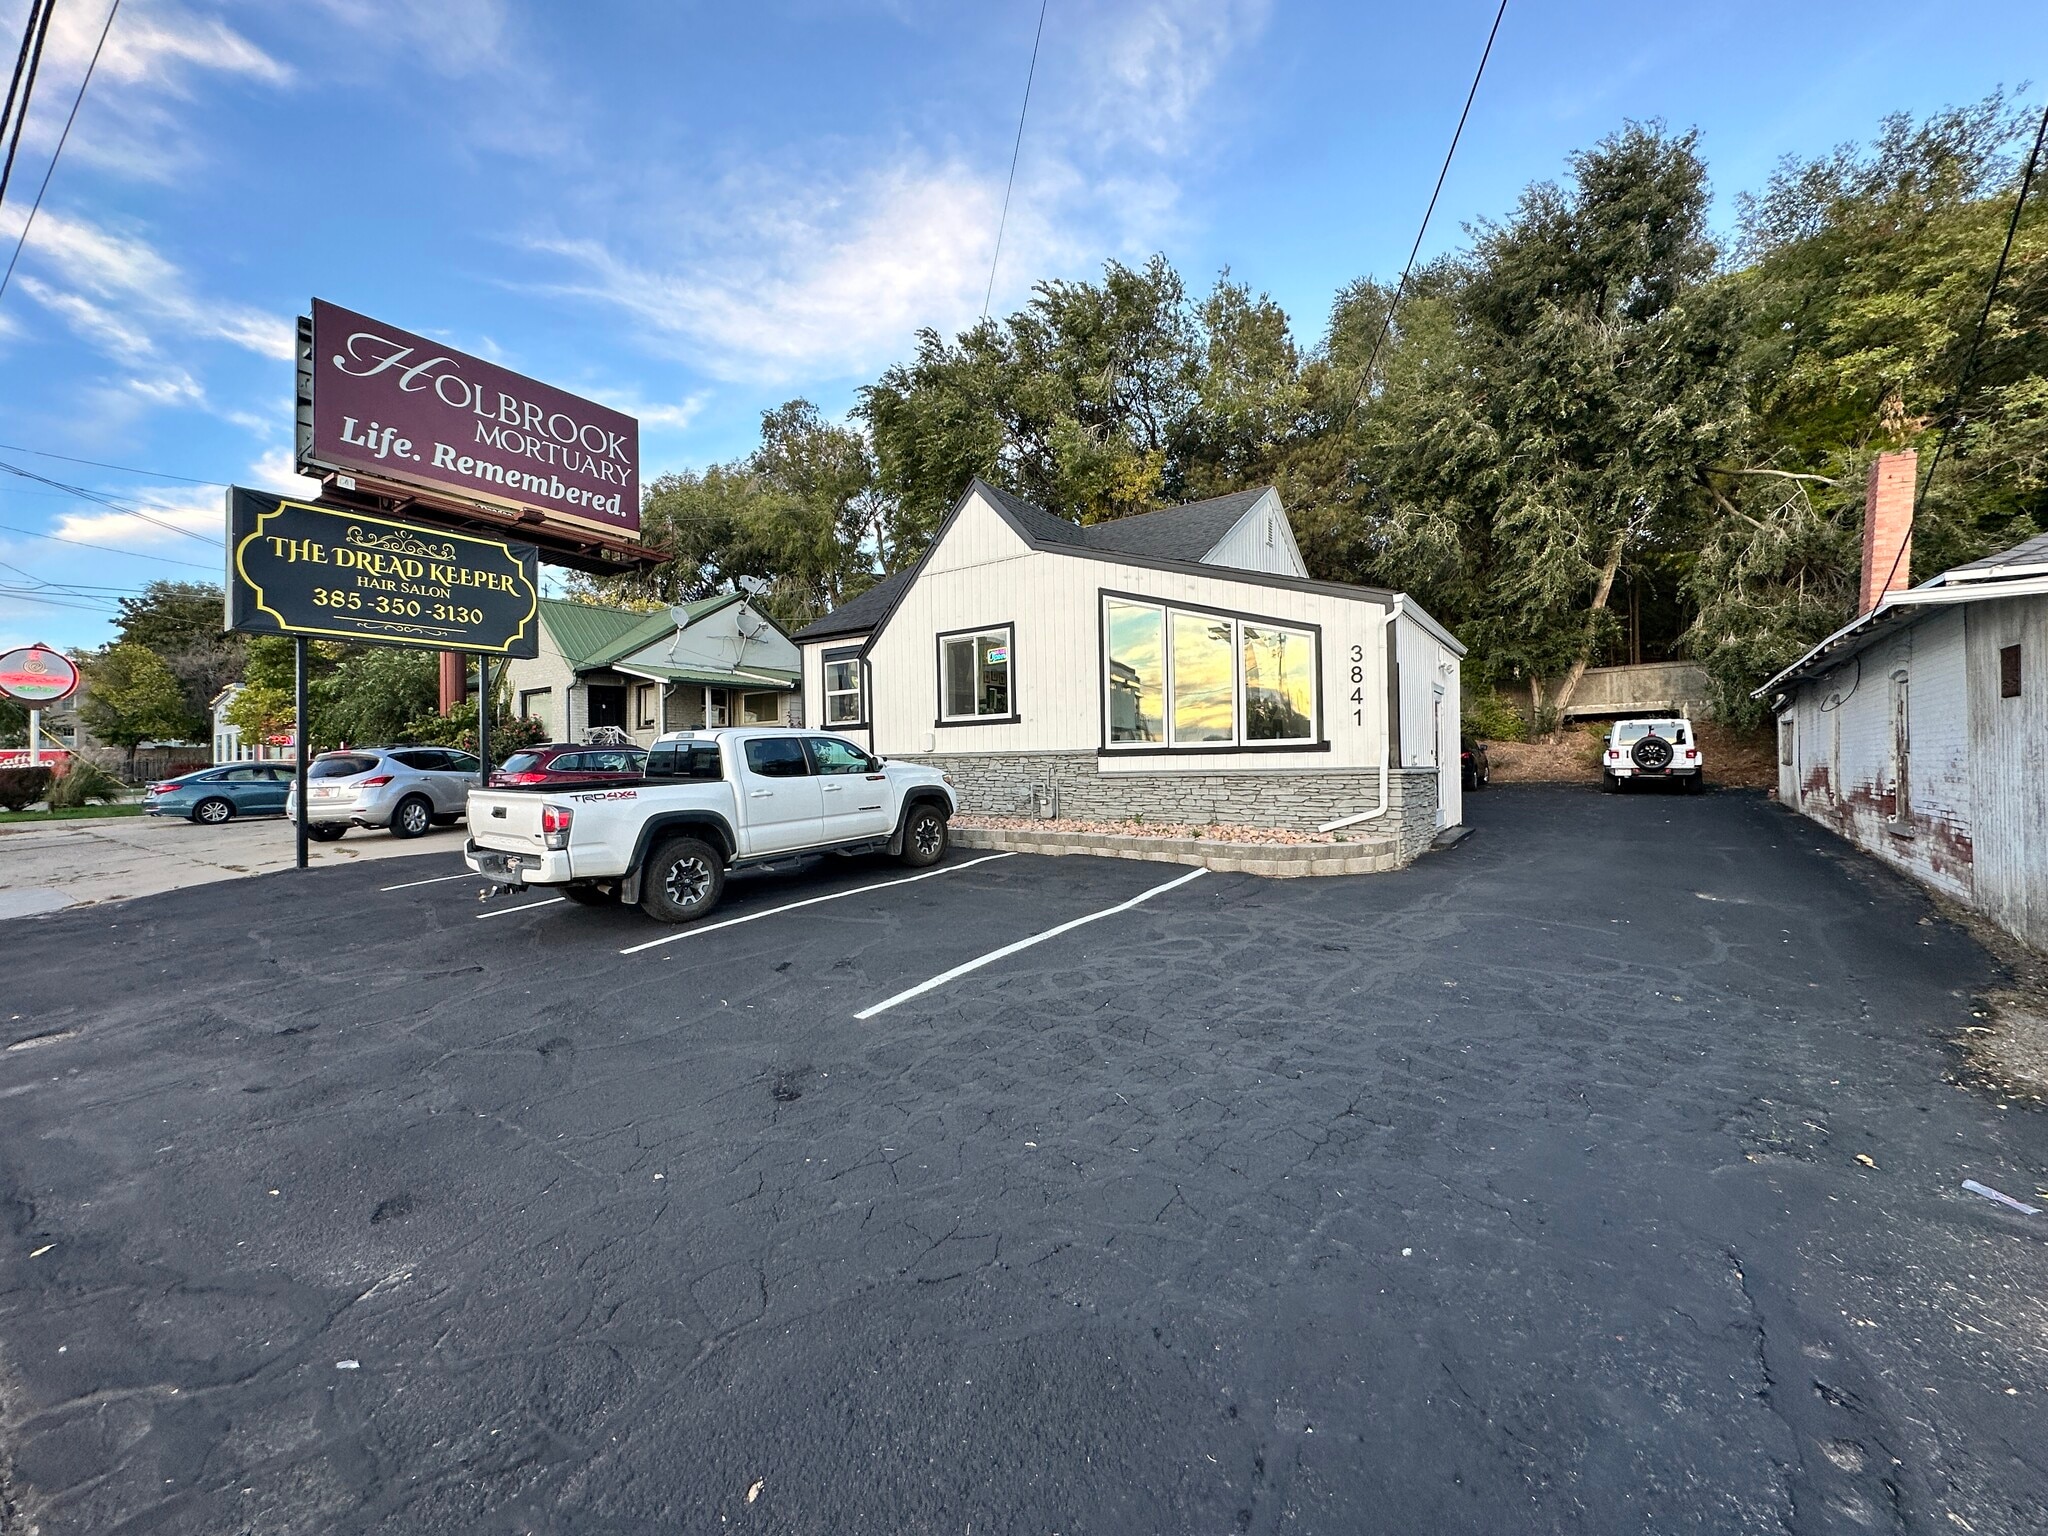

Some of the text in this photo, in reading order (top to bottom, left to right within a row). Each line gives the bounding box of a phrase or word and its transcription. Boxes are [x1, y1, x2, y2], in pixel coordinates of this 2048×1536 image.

[332, 332, 631, 465] HOLBROOK
[339, 416, 627, 518] Life. Remembered.
[474, 420, 632, 487] MORTUARY
[266, 536, 522, 598] THE DREAD KEEPER
[356, 575, 451, 599] HAIR SALON
[1350, 645, 1364, 727] 3841
